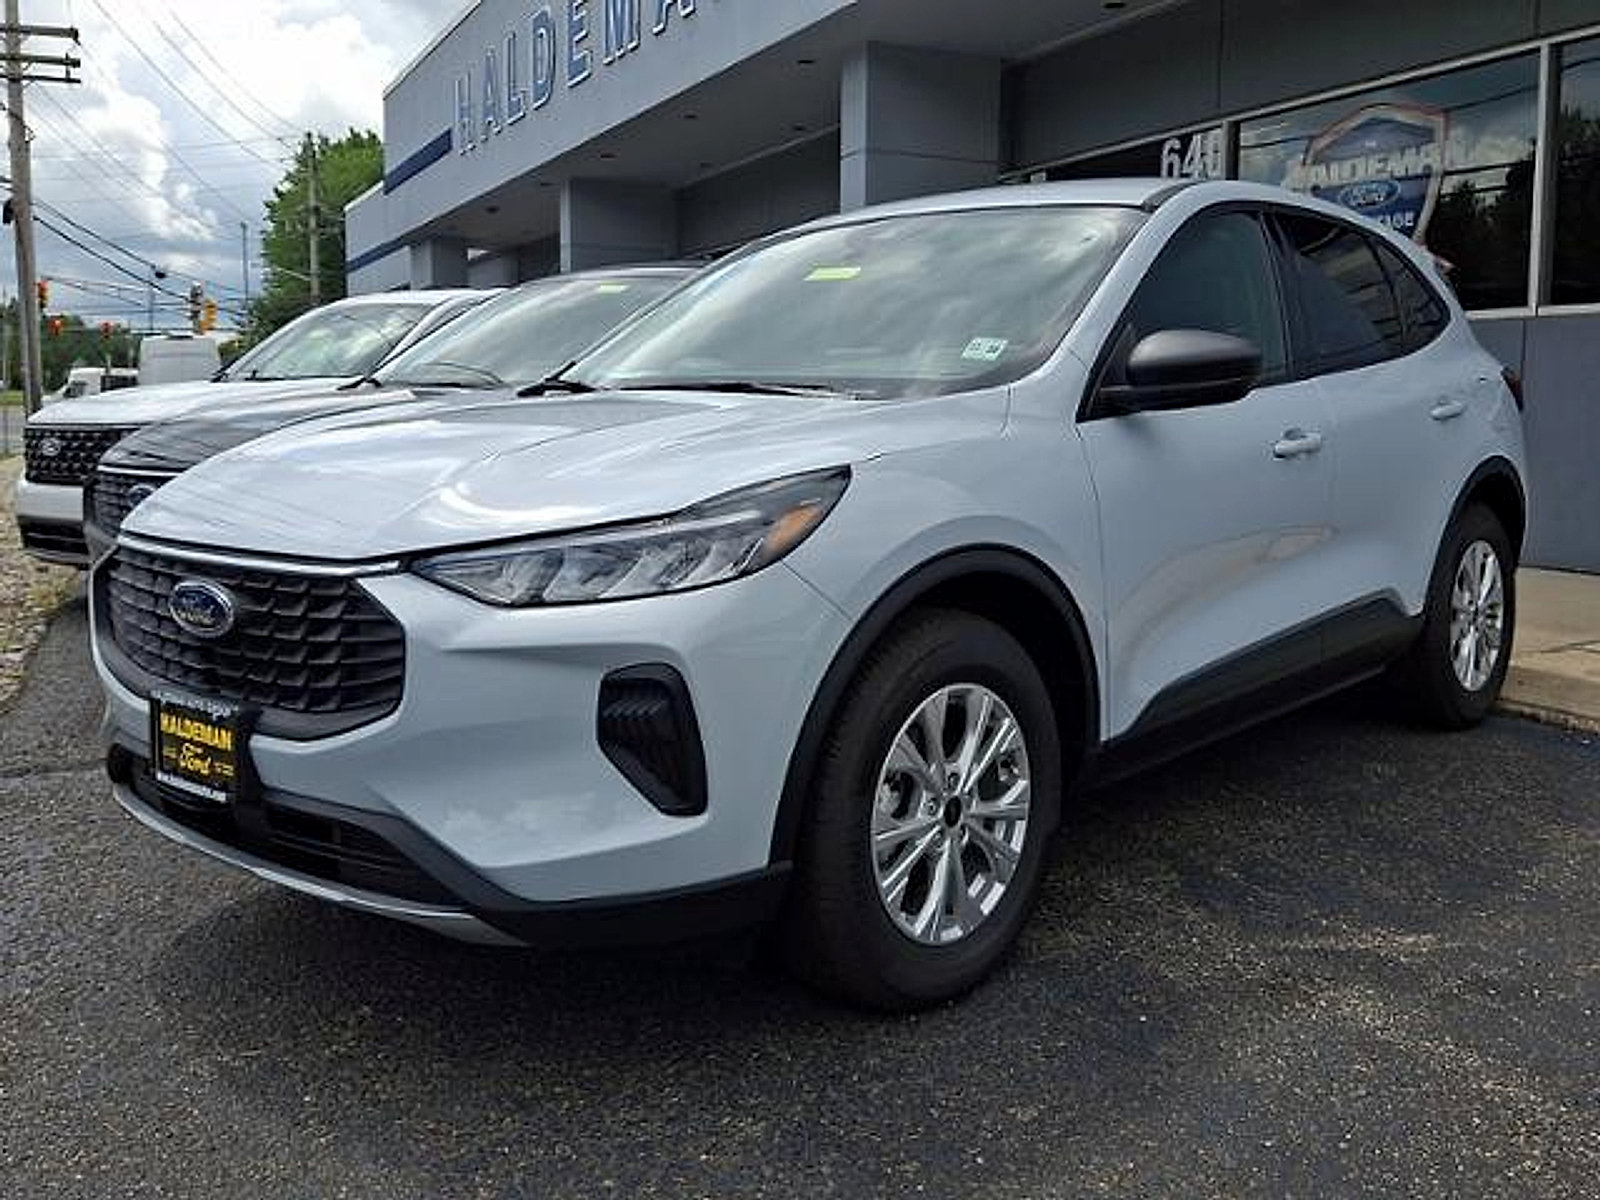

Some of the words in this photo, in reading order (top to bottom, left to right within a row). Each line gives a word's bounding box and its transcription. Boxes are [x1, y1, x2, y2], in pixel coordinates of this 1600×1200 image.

[455, 0, 696, 156] HALDEM
[160, 711, 232, 752] HALDEMAN
[179, 741, 212, 775] Ford
